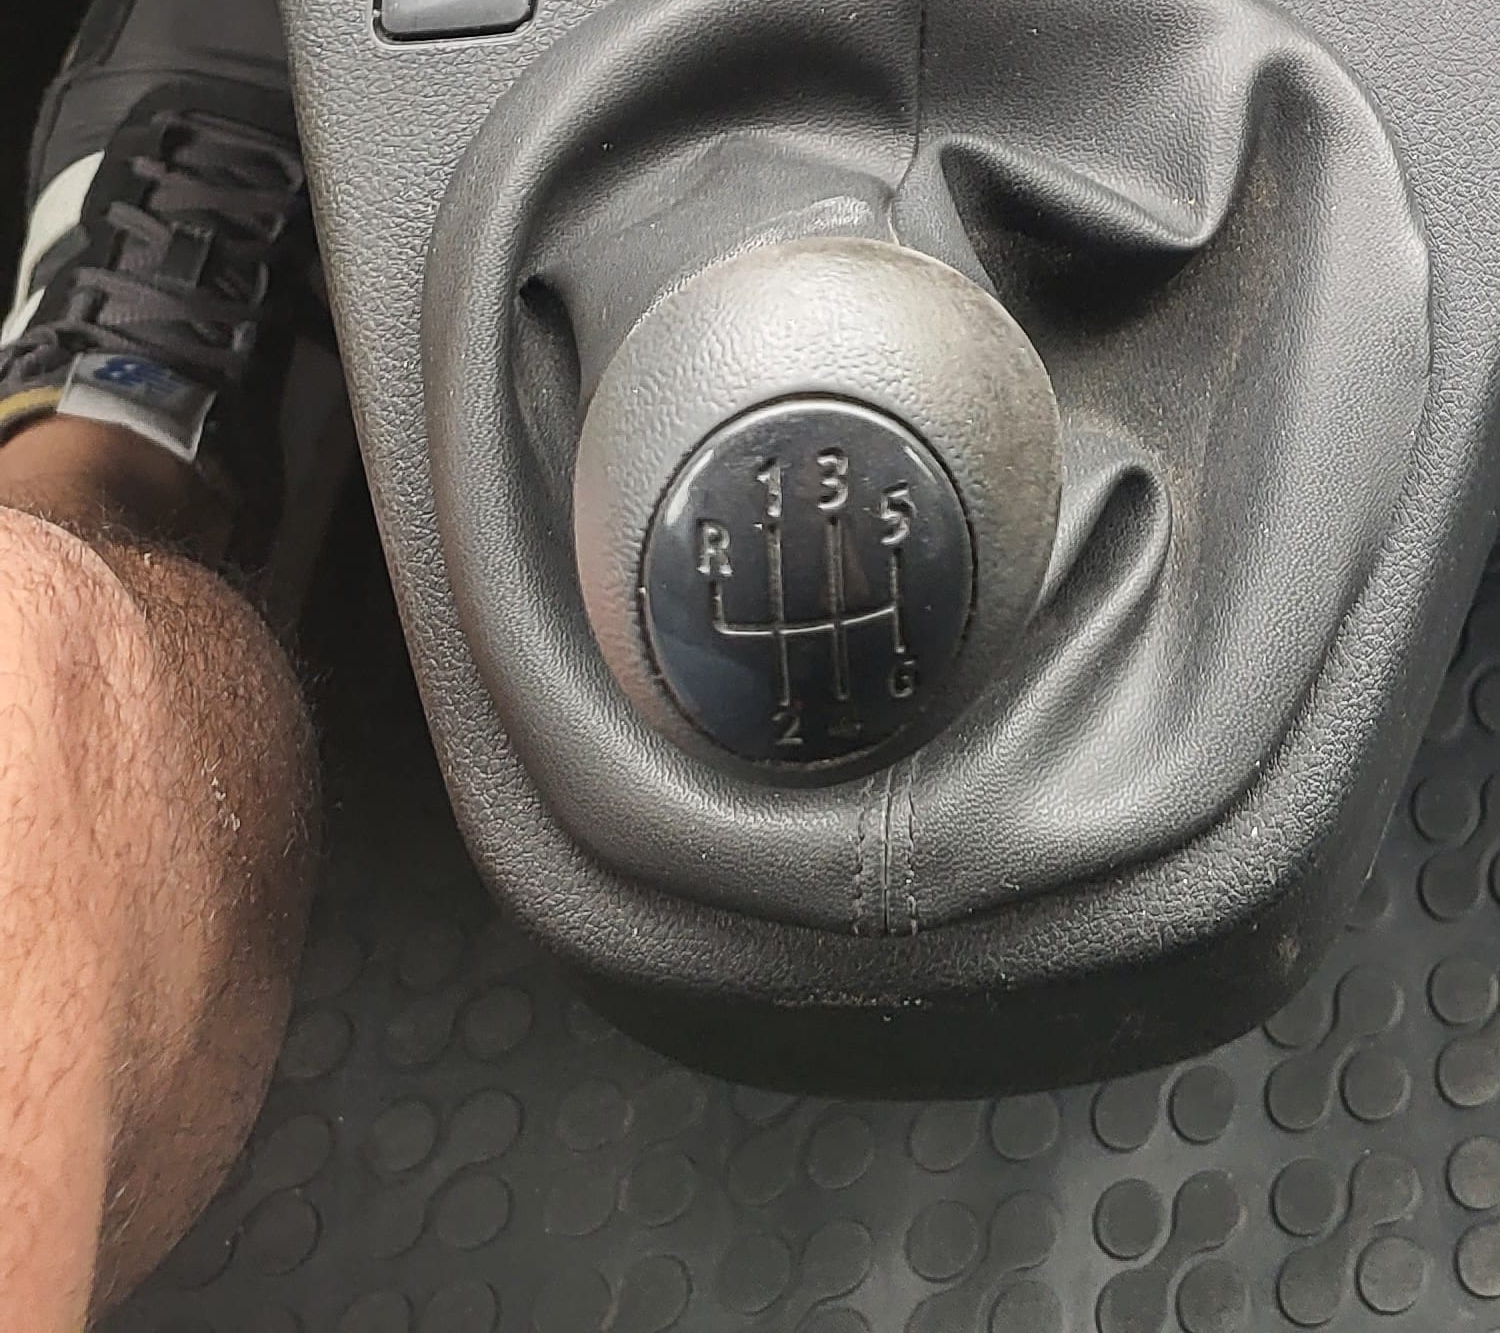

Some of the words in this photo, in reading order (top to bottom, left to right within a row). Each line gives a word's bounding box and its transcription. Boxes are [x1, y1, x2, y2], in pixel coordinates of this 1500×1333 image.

[756, 457, 783, 518] 1
[815, 446, 850, 510] 3
[879, 479, 918, 546] 5
[696, 519, 734, 578] R
[771, 710, 805, 747] 2
